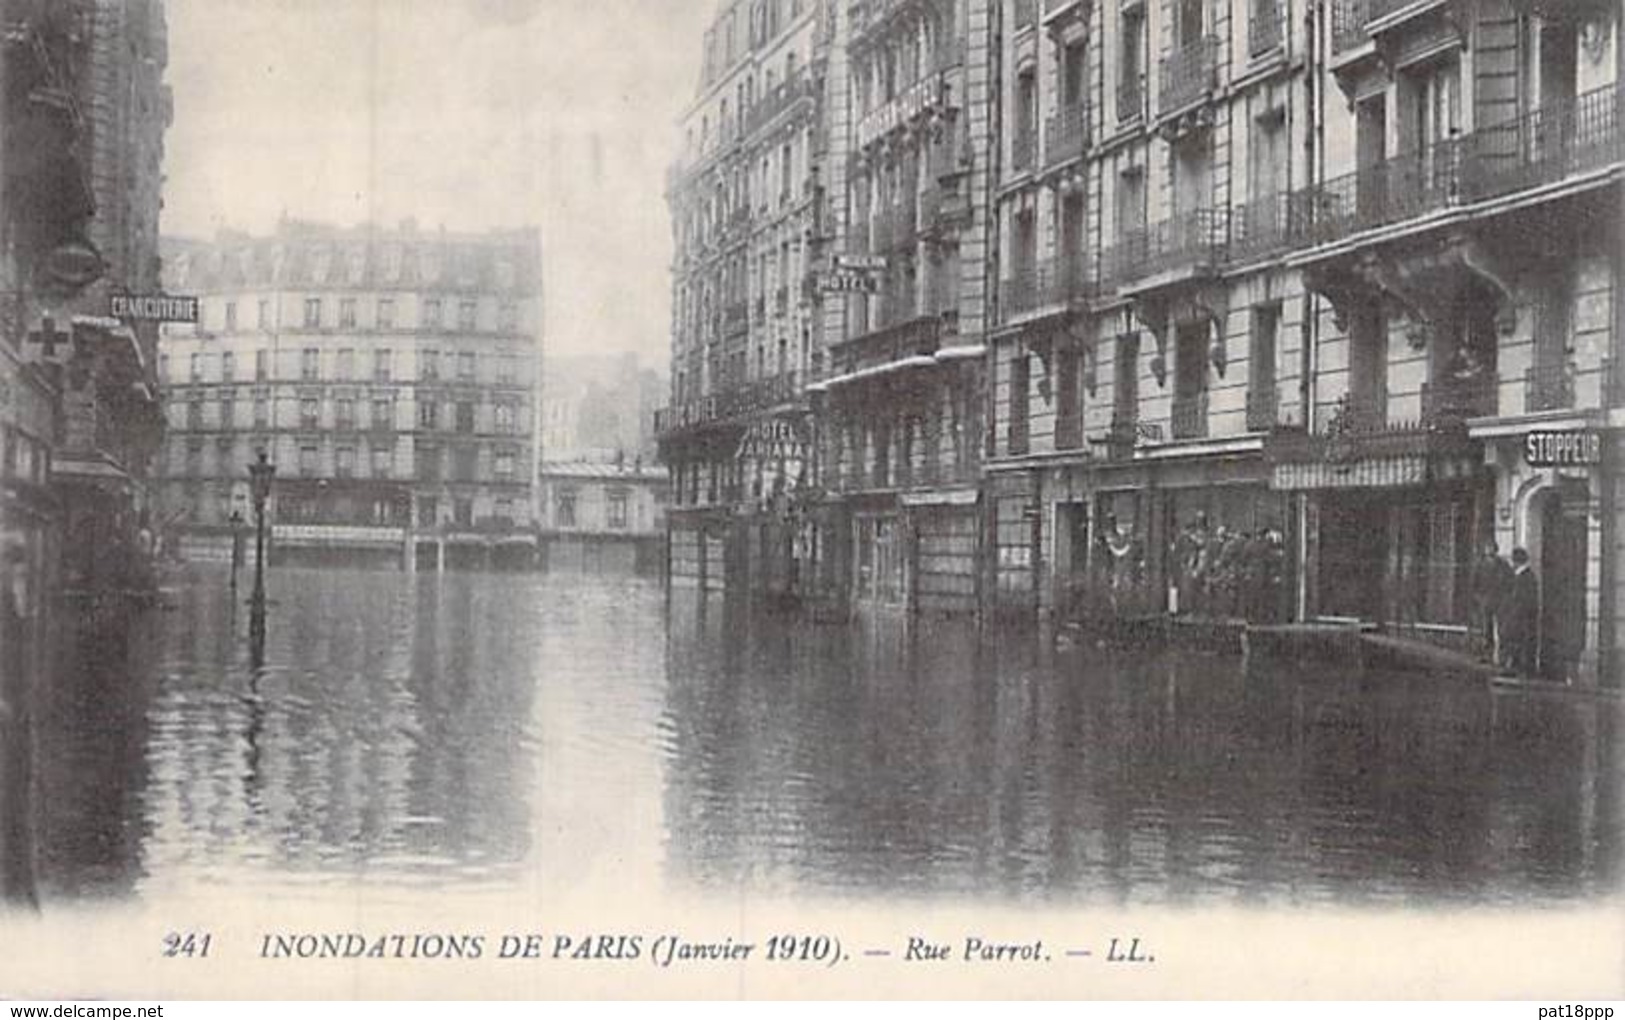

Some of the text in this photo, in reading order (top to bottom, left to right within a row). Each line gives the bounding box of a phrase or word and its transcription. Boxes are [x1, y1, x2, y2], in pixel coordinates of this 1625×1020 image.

[818, 276, 868, 291] HOTEL
[111, 296, 196, 320] CHARCUTERIE
[751, 419, 797, 442] HOTEL
[1527, 433, 1600, 463] STOPPEUR
